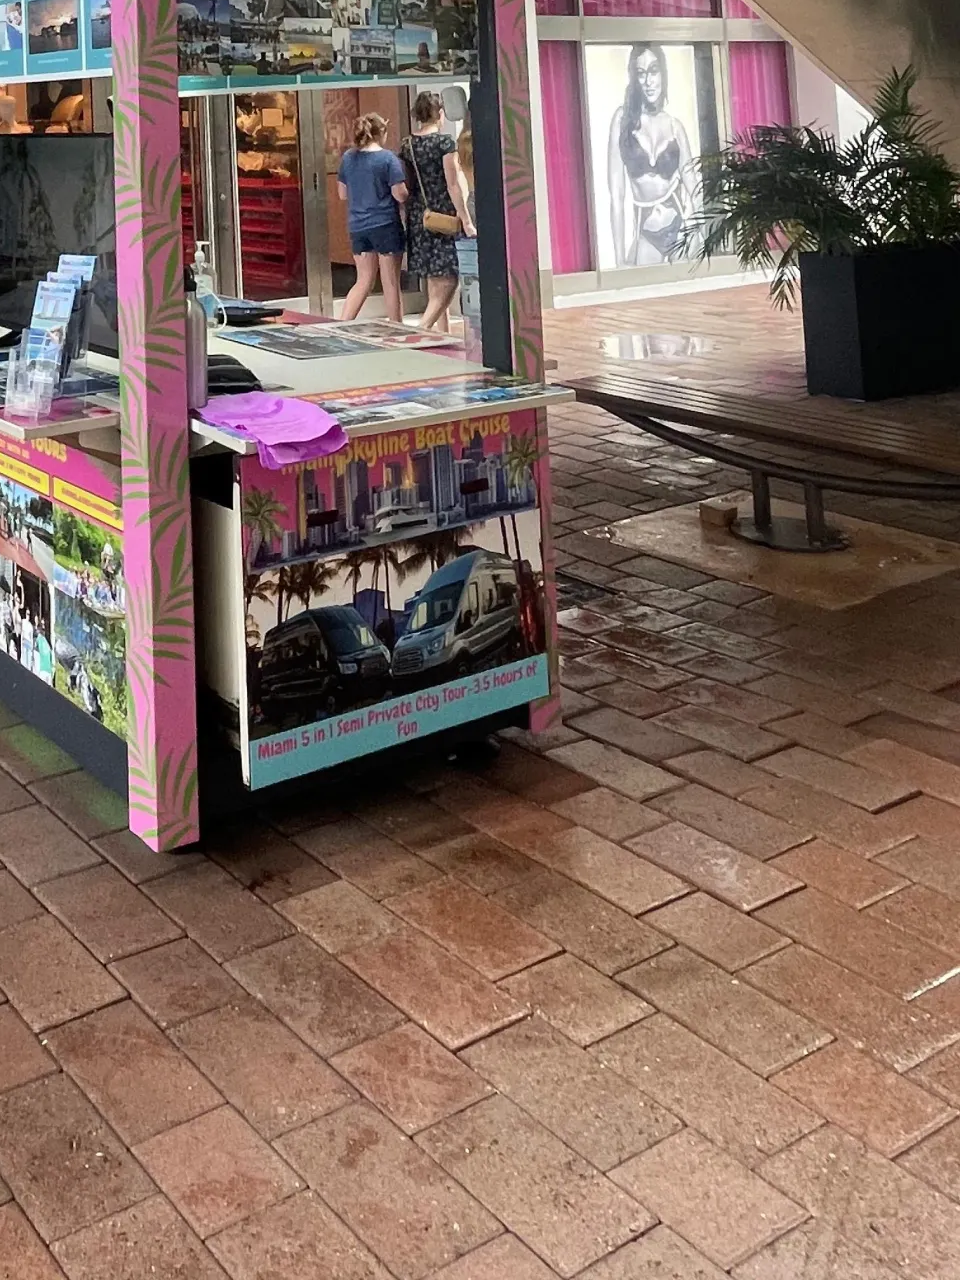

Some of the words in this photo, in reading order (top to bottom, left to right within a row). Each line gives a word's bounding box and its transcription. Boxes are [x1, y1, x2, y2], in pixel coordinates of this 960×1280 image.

[414, 421, 455, 449] Boat
[459, 414, 511, 447] Cruise
[257, 734, 297, 761] Miami
[301, 730, 310, 747] 5
[313, 727, 325, 744] in
[337, 716, 364, 737] Semi
[367, 699, 412, 727] Private
[415, 691, 439, 712] City
[493, 666, 523, 688] hours
[526, 661, 538, 676] of
[397, 720, 418, 738] Fun
